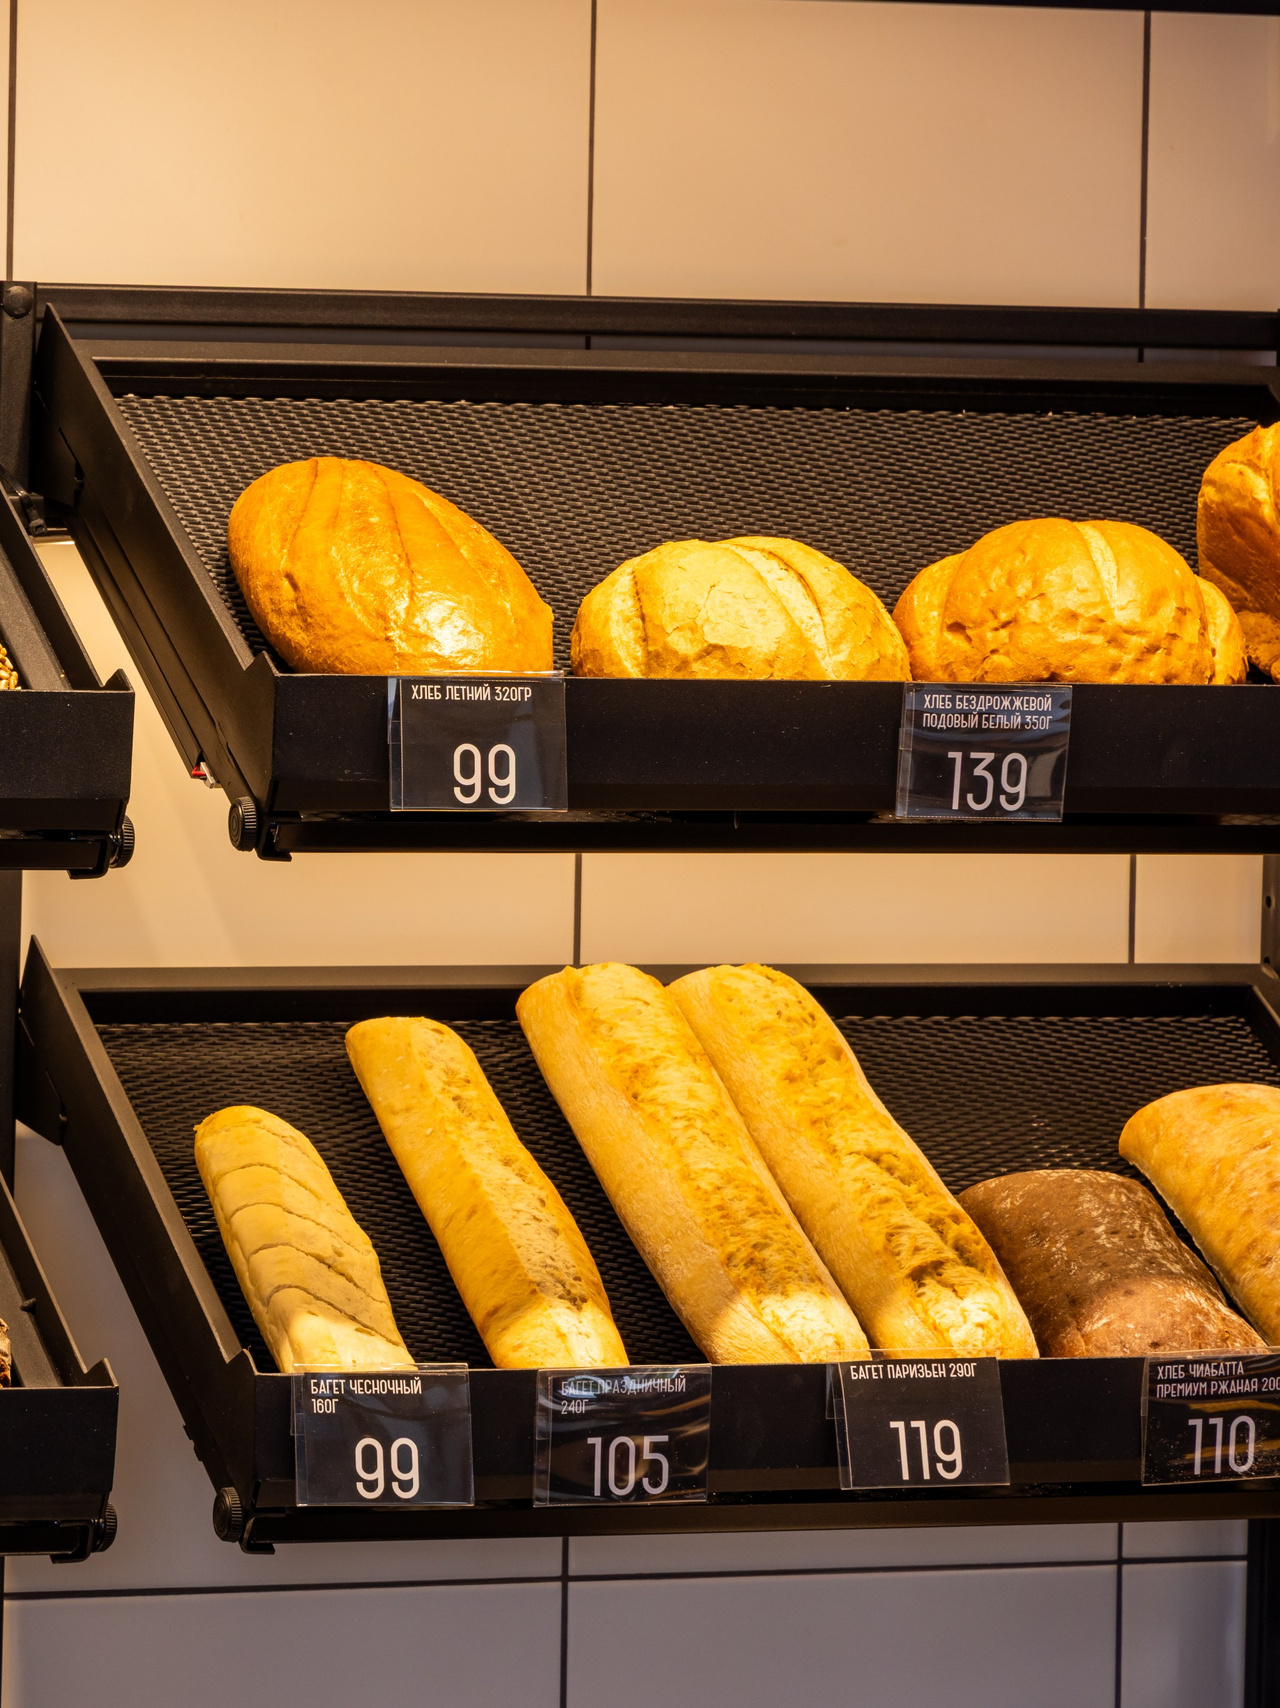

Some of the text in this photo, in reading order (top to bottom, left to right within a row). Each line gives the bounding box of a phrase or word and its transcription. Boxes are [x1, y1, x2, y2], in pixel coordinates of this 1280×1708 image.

[412, 683, 532, 701] ХЛЕБ ЛЕТНИЙ 320ГР
[924, 694, 1052, 711] ХЛЕБ БЕЗДРОЖЖЕВОЙ
[922, 711, 1053, 730] ПОДОВЫЙ БЕЛЫЙ 350Г
[453, 743, 516, 805] 99
[947, 751, 1028, 812] 139
[850, 1362, 977, 1380] БАГЕТ ПАРИЗЬЕН 290Г
[1157, 1361, 1245, 1380] ХЛЕБ ЧИАБАТТА
[310, 1376, 422, 1395] БАГЕТ ЧЕСНОЧНЫЙ
[561, 1375, 686, 1396] БАГЕТ ПРАЗДНИЧНЫЙ
[1156, 1381, 1207, 1398] ПРЕМИУМ
[1210, 1378, 1258, 1395] РЖАНАЯ
[311, 1398, 339, 1414] 160Г
[561, 1399, 589, 1415] 240Г
[889, 1419, 963, 1481] 119
[1188, 1415, 1256, 1475] 110
[355, 1437, 420, 1499] 99
[587, 1435, 669, 1497] 105
